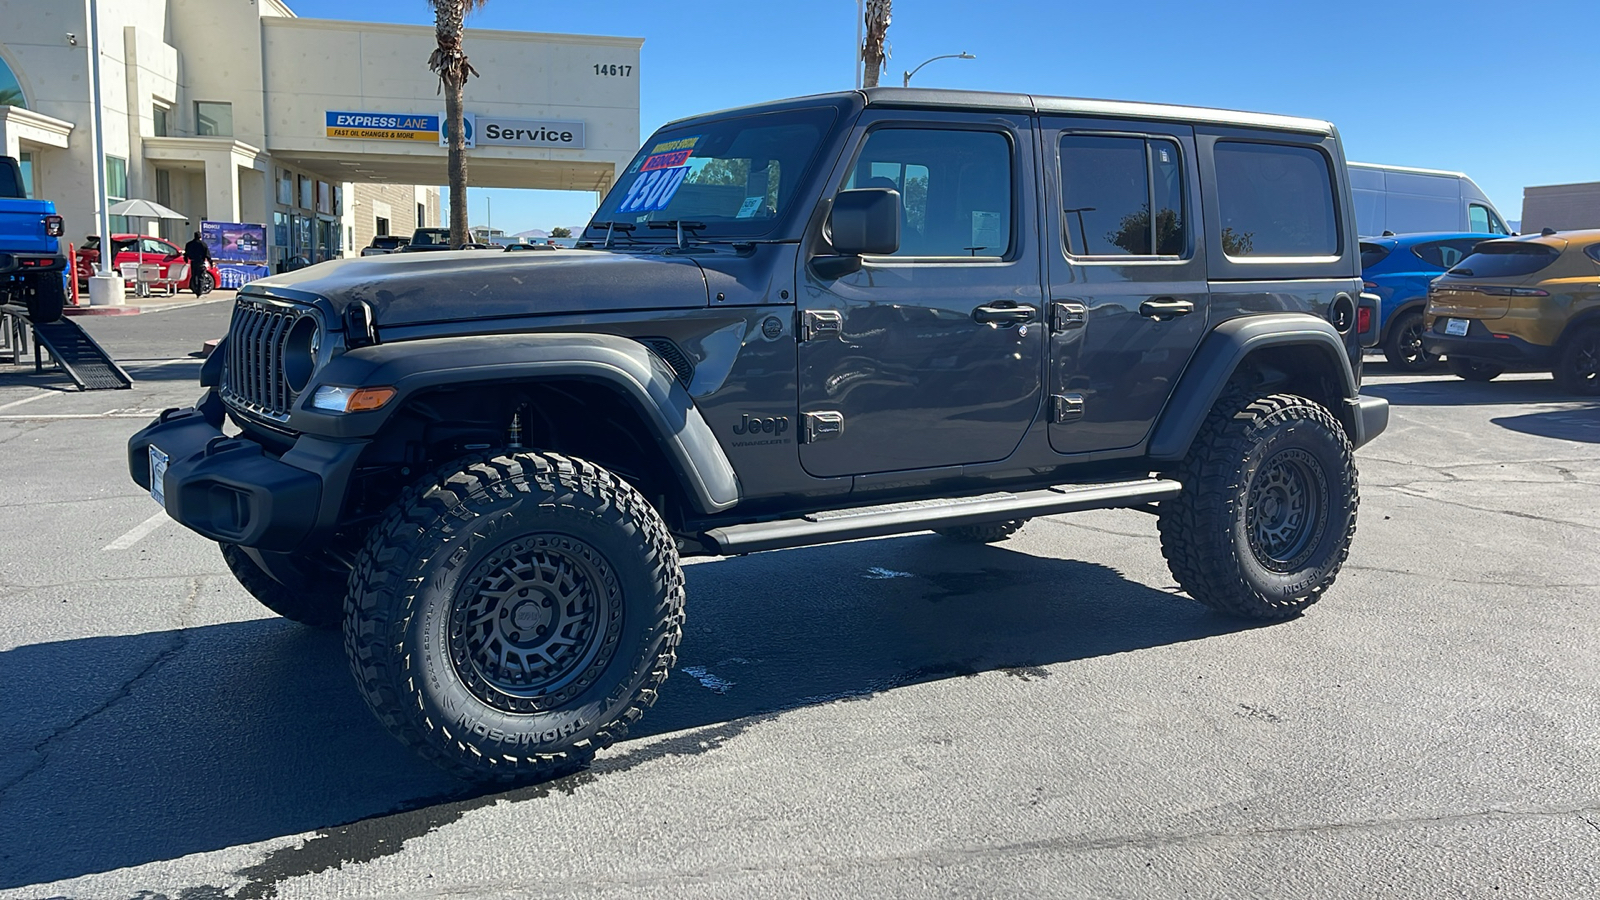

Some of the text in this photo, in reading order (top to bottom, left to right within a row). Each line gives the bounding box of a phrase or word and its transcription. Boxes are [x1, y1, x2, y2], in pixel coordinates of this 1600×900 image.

[593, 63, 632, 77] 14617
[486, 124, 573, 143] Service
[646, 151, 688, 169] REDUCED
[620, 167, 687, 210] 9300
[732, 413, 789, 436] Jeep
[732, 439, 782, 447] WRANGLER
[458, 712, 590, 746] THOMPSON
